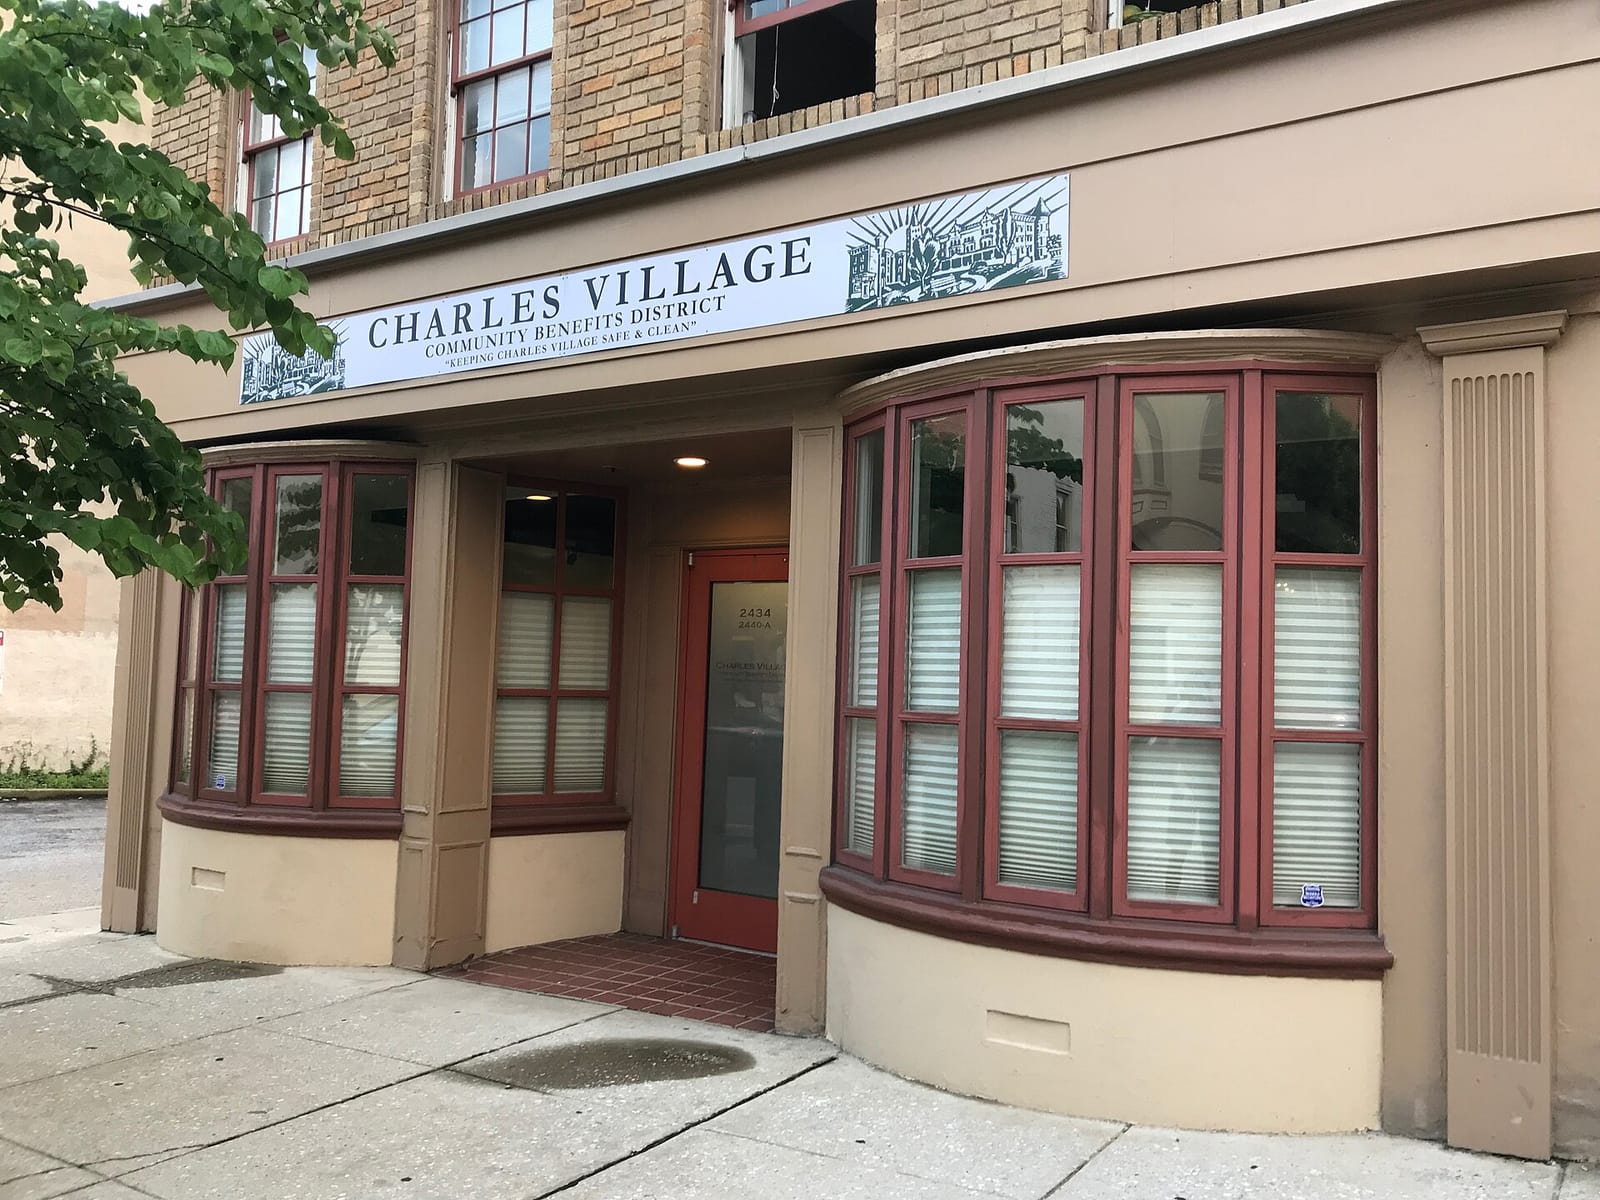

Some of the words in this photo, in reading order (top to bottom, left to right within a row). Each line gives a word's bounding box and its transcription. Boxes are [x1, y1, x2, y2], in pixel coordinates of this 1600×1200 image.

[368, 285, 561, 349] CHARLES
[583, 236, 812, 311] VILLAGE
[425, 328, 528, 359] COMMUNITY
[534, 312, 623, 341] BENEFITS
[630, 295, 726, 324] DISTRICT
[445, 352, 494, 368] “KEEPING
[497, 344, 547, 360] CHARLES
[551, 336, 598, 351] VILLAGE
[602, 330, 631, 344] SAFE
[634, 329, 643, 340] &
[647, 321, 697, 337] CLEAN”
[738, 621, 771, 630] 2440-A
[739, 608, 771, 618] 2434
